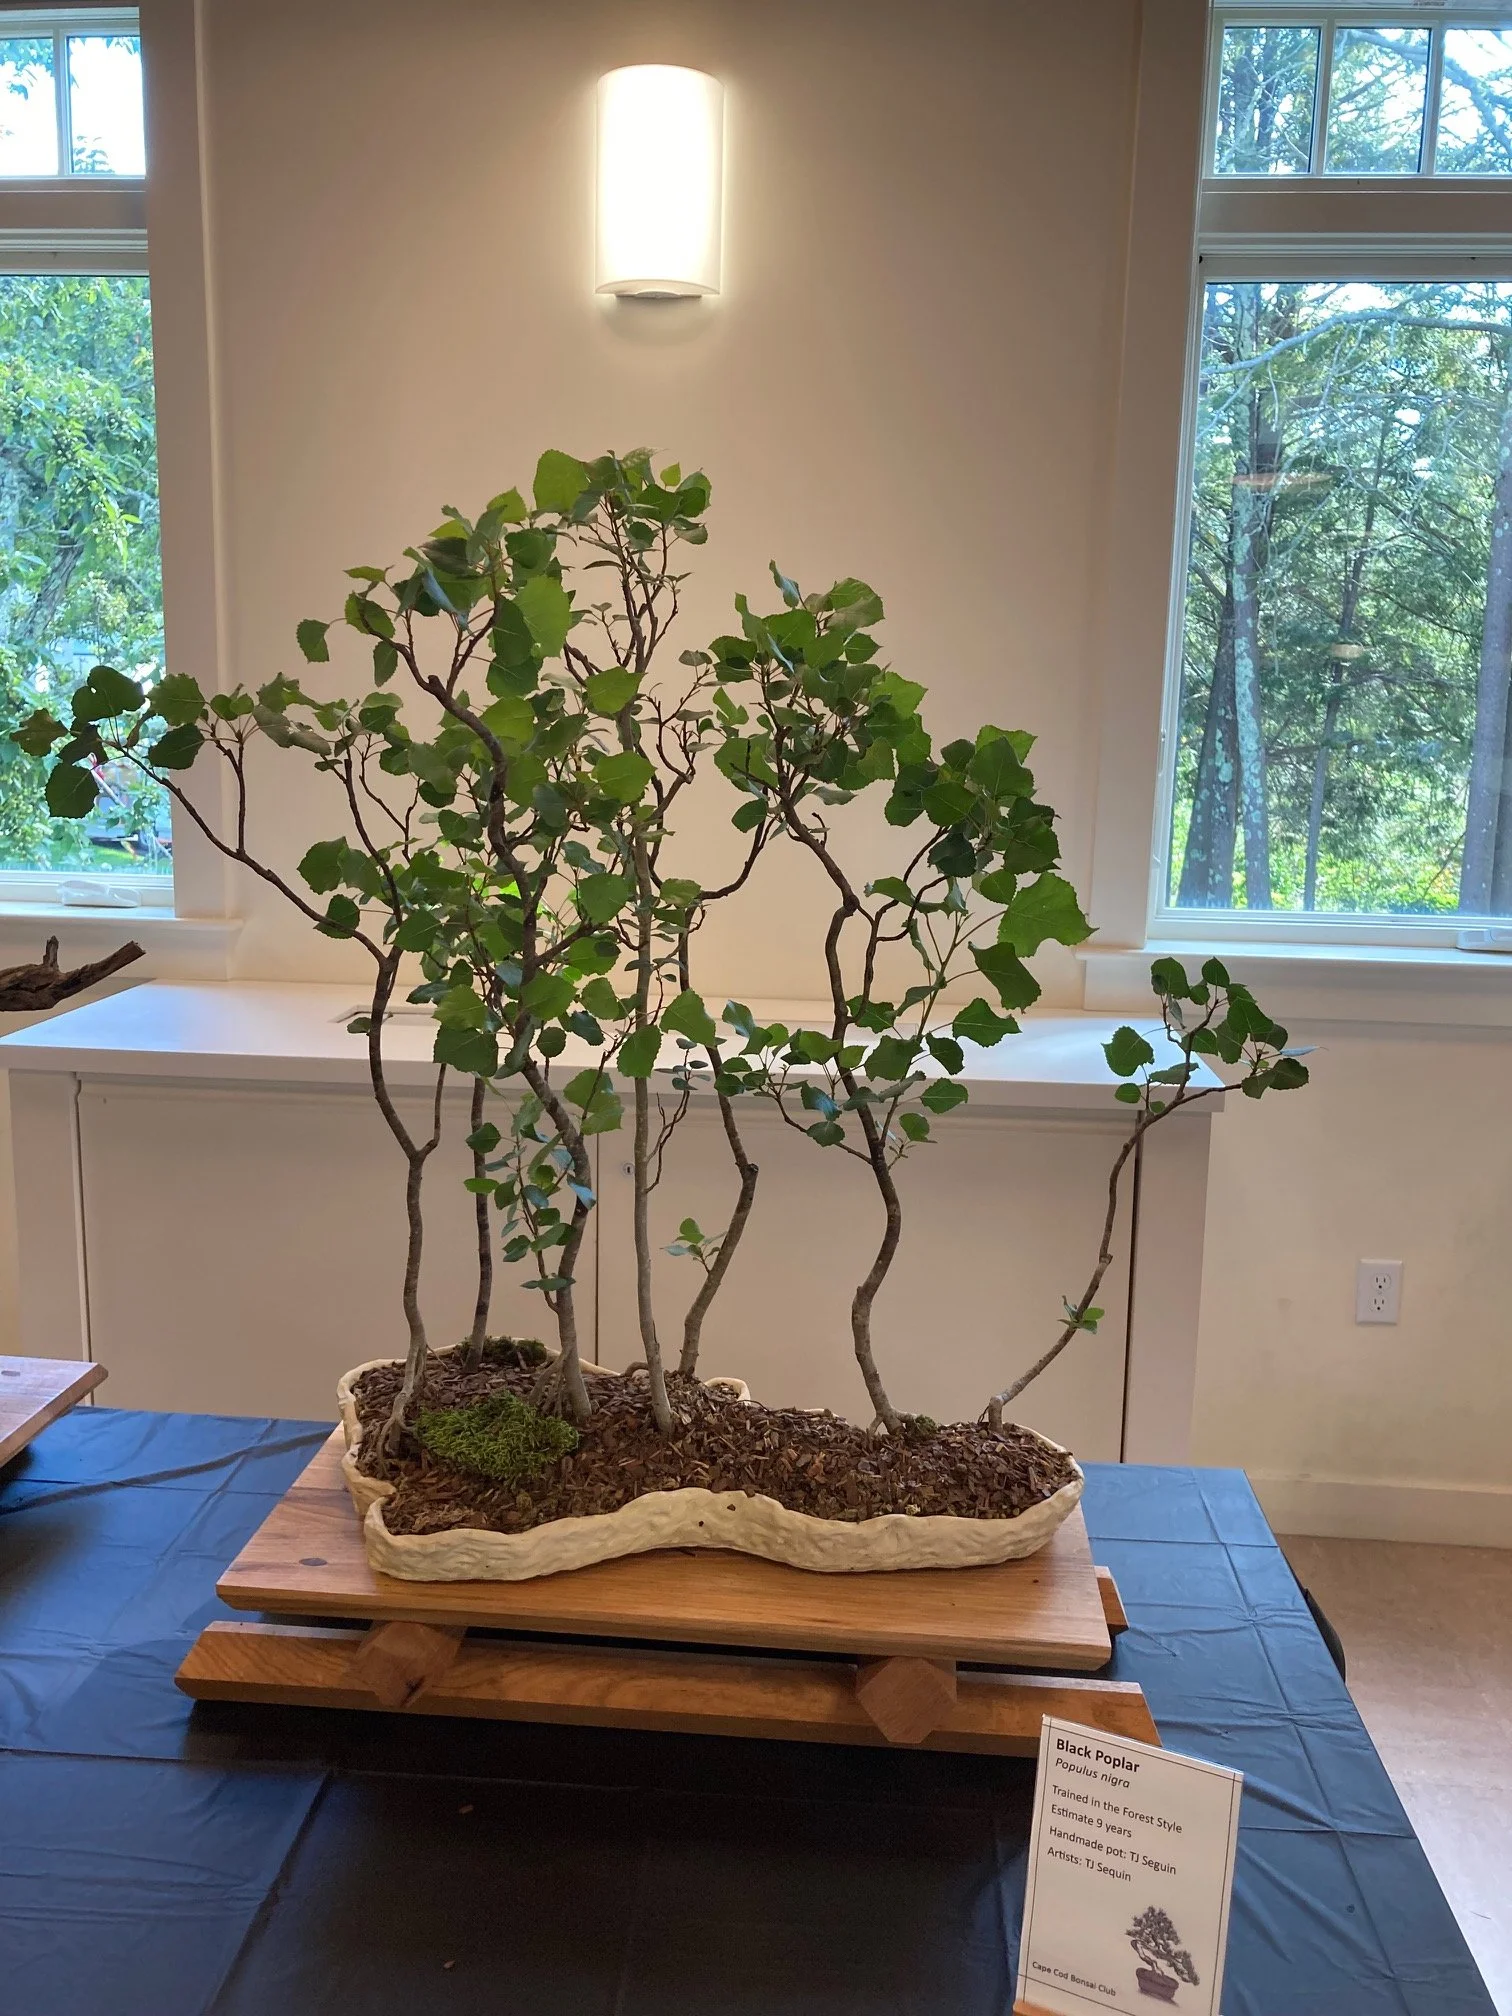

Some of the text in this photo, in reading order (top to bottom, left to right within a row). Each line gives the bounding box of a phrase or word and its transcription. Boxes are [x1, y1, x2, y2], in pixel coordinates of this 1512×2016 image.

[1055, 1757, 1130, 1788] Populus nigra
[1056, 1738, 1140, 1773] Black Poplar
[1051, 1804, 1132, 1838] Estimate 9 years
[1052, 1784, 1183, 1834] Trained in the Forest Style
[1047, 1846, 1082, 1866] Artists:
[1085, 1858, 1094, 1870] TJ
[1049, 1826, 1177, 1875] Handmade pot: TJ Seguin
[1032, 1961, 1116, 1997] Cape Cod Bonsai Club
